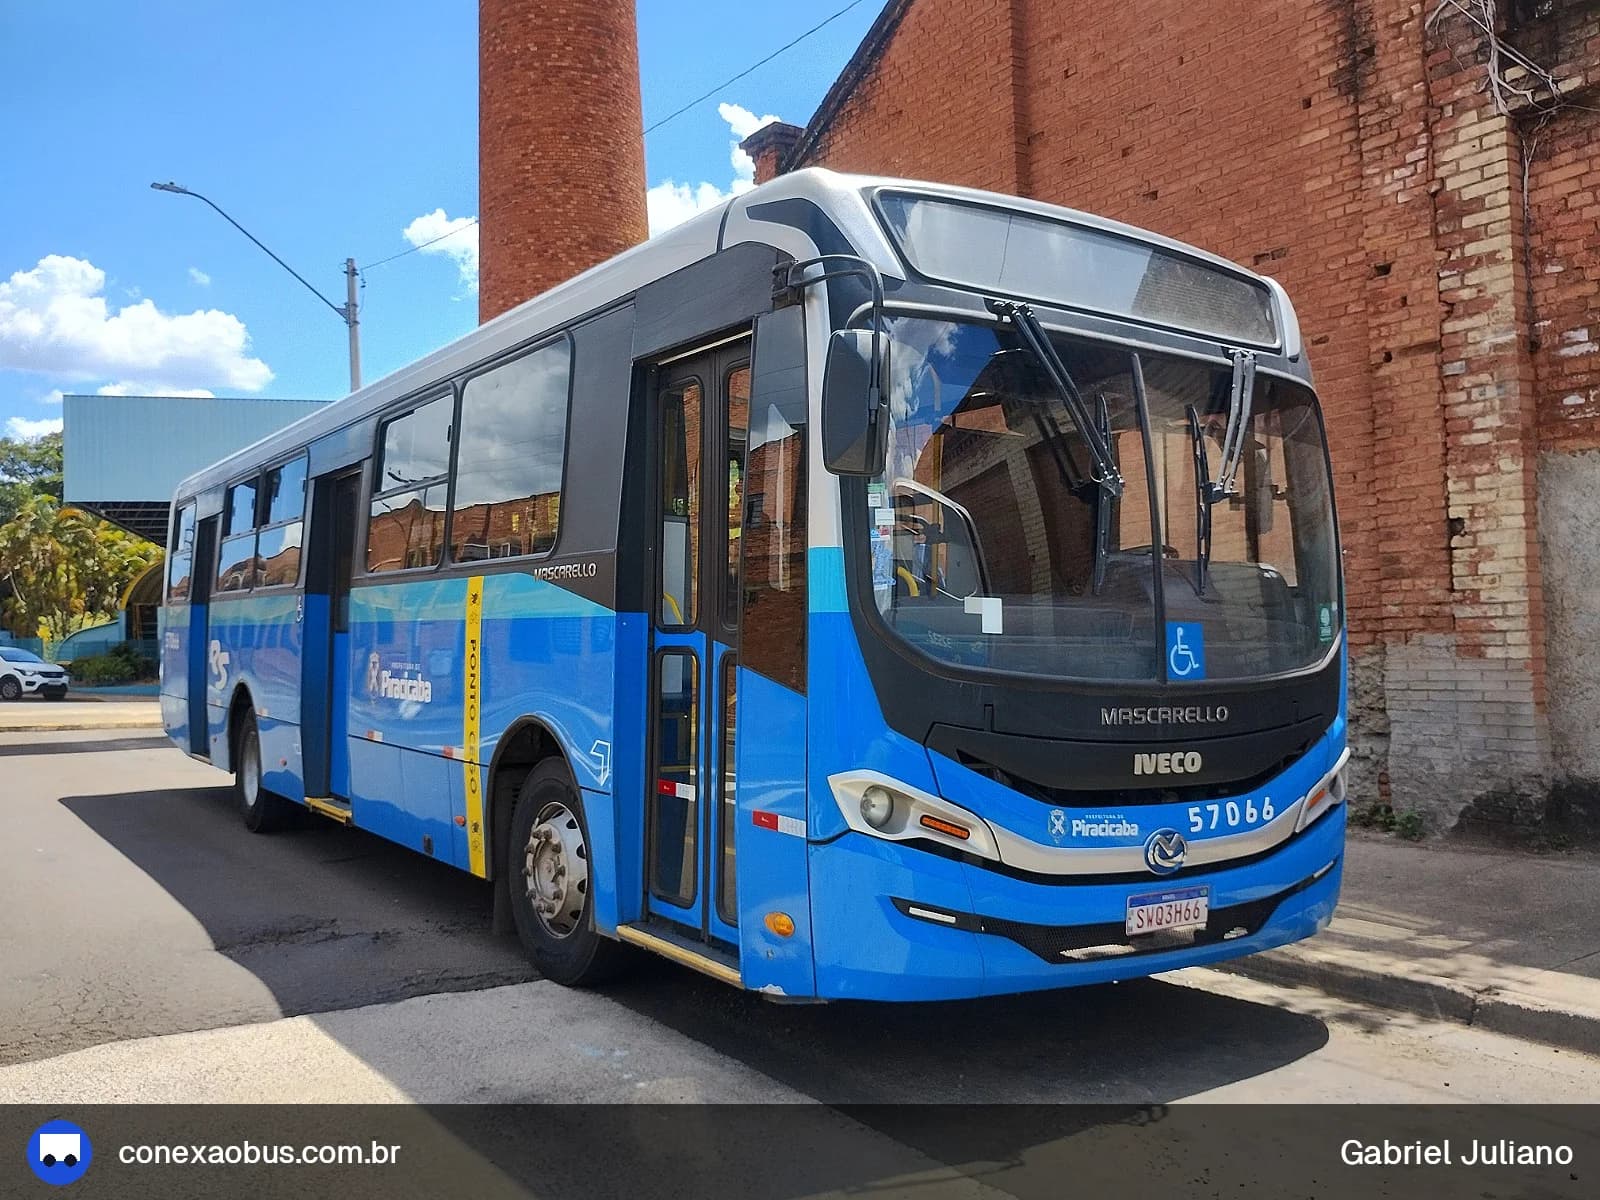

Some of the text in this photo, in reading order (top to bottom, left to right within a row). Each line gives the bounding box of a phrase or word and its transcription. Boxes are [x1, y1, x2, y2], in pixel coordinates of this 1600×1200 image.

[534, 562, 597, 581] MASCARELLO
[469, 639, 477, 721] PONTO
[1101, 706, 1229, 725] MASCARELLO
[1134, 751, 1202, 775] IVECO
[1188, 797, 1275, 833] 57066
[1071, 819, 1139, 837] Piracicaba
[1136, 901, 1201, 929] SWQ3H66
